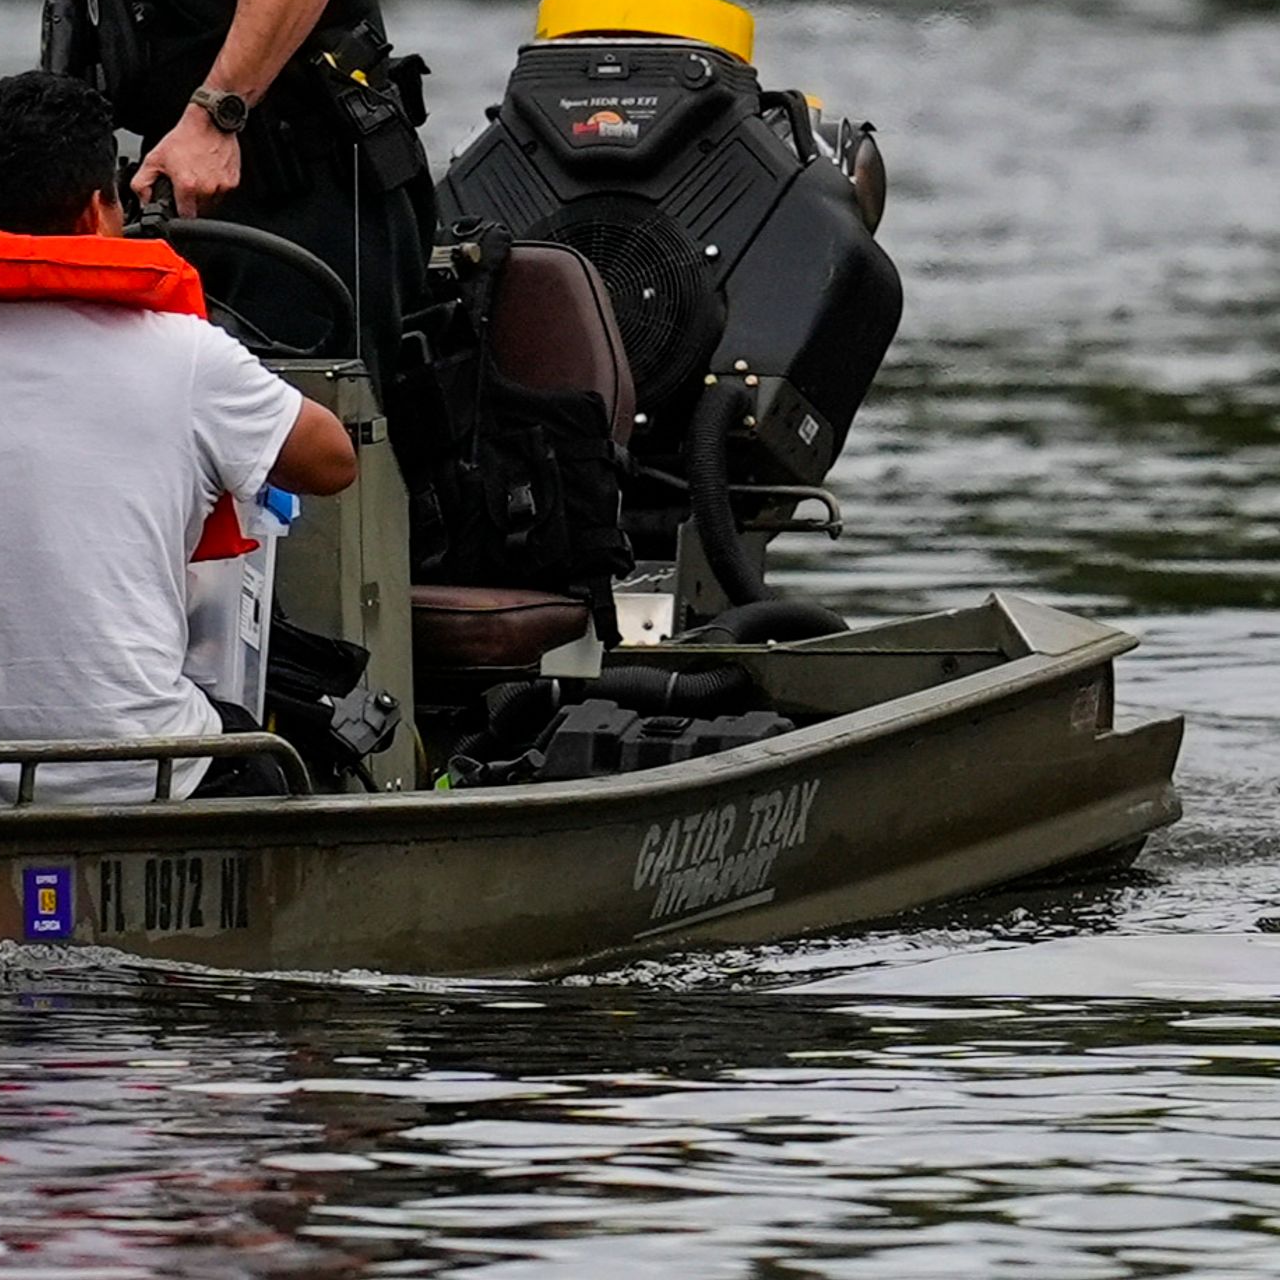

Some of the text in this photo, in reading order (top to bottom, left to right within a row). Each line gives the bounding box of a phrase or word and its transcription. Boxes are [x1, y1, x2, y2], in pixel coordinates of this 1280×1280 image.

[633, 778, 820, 890] GATOR TRAX
[100, 860, 125, 932] FL
